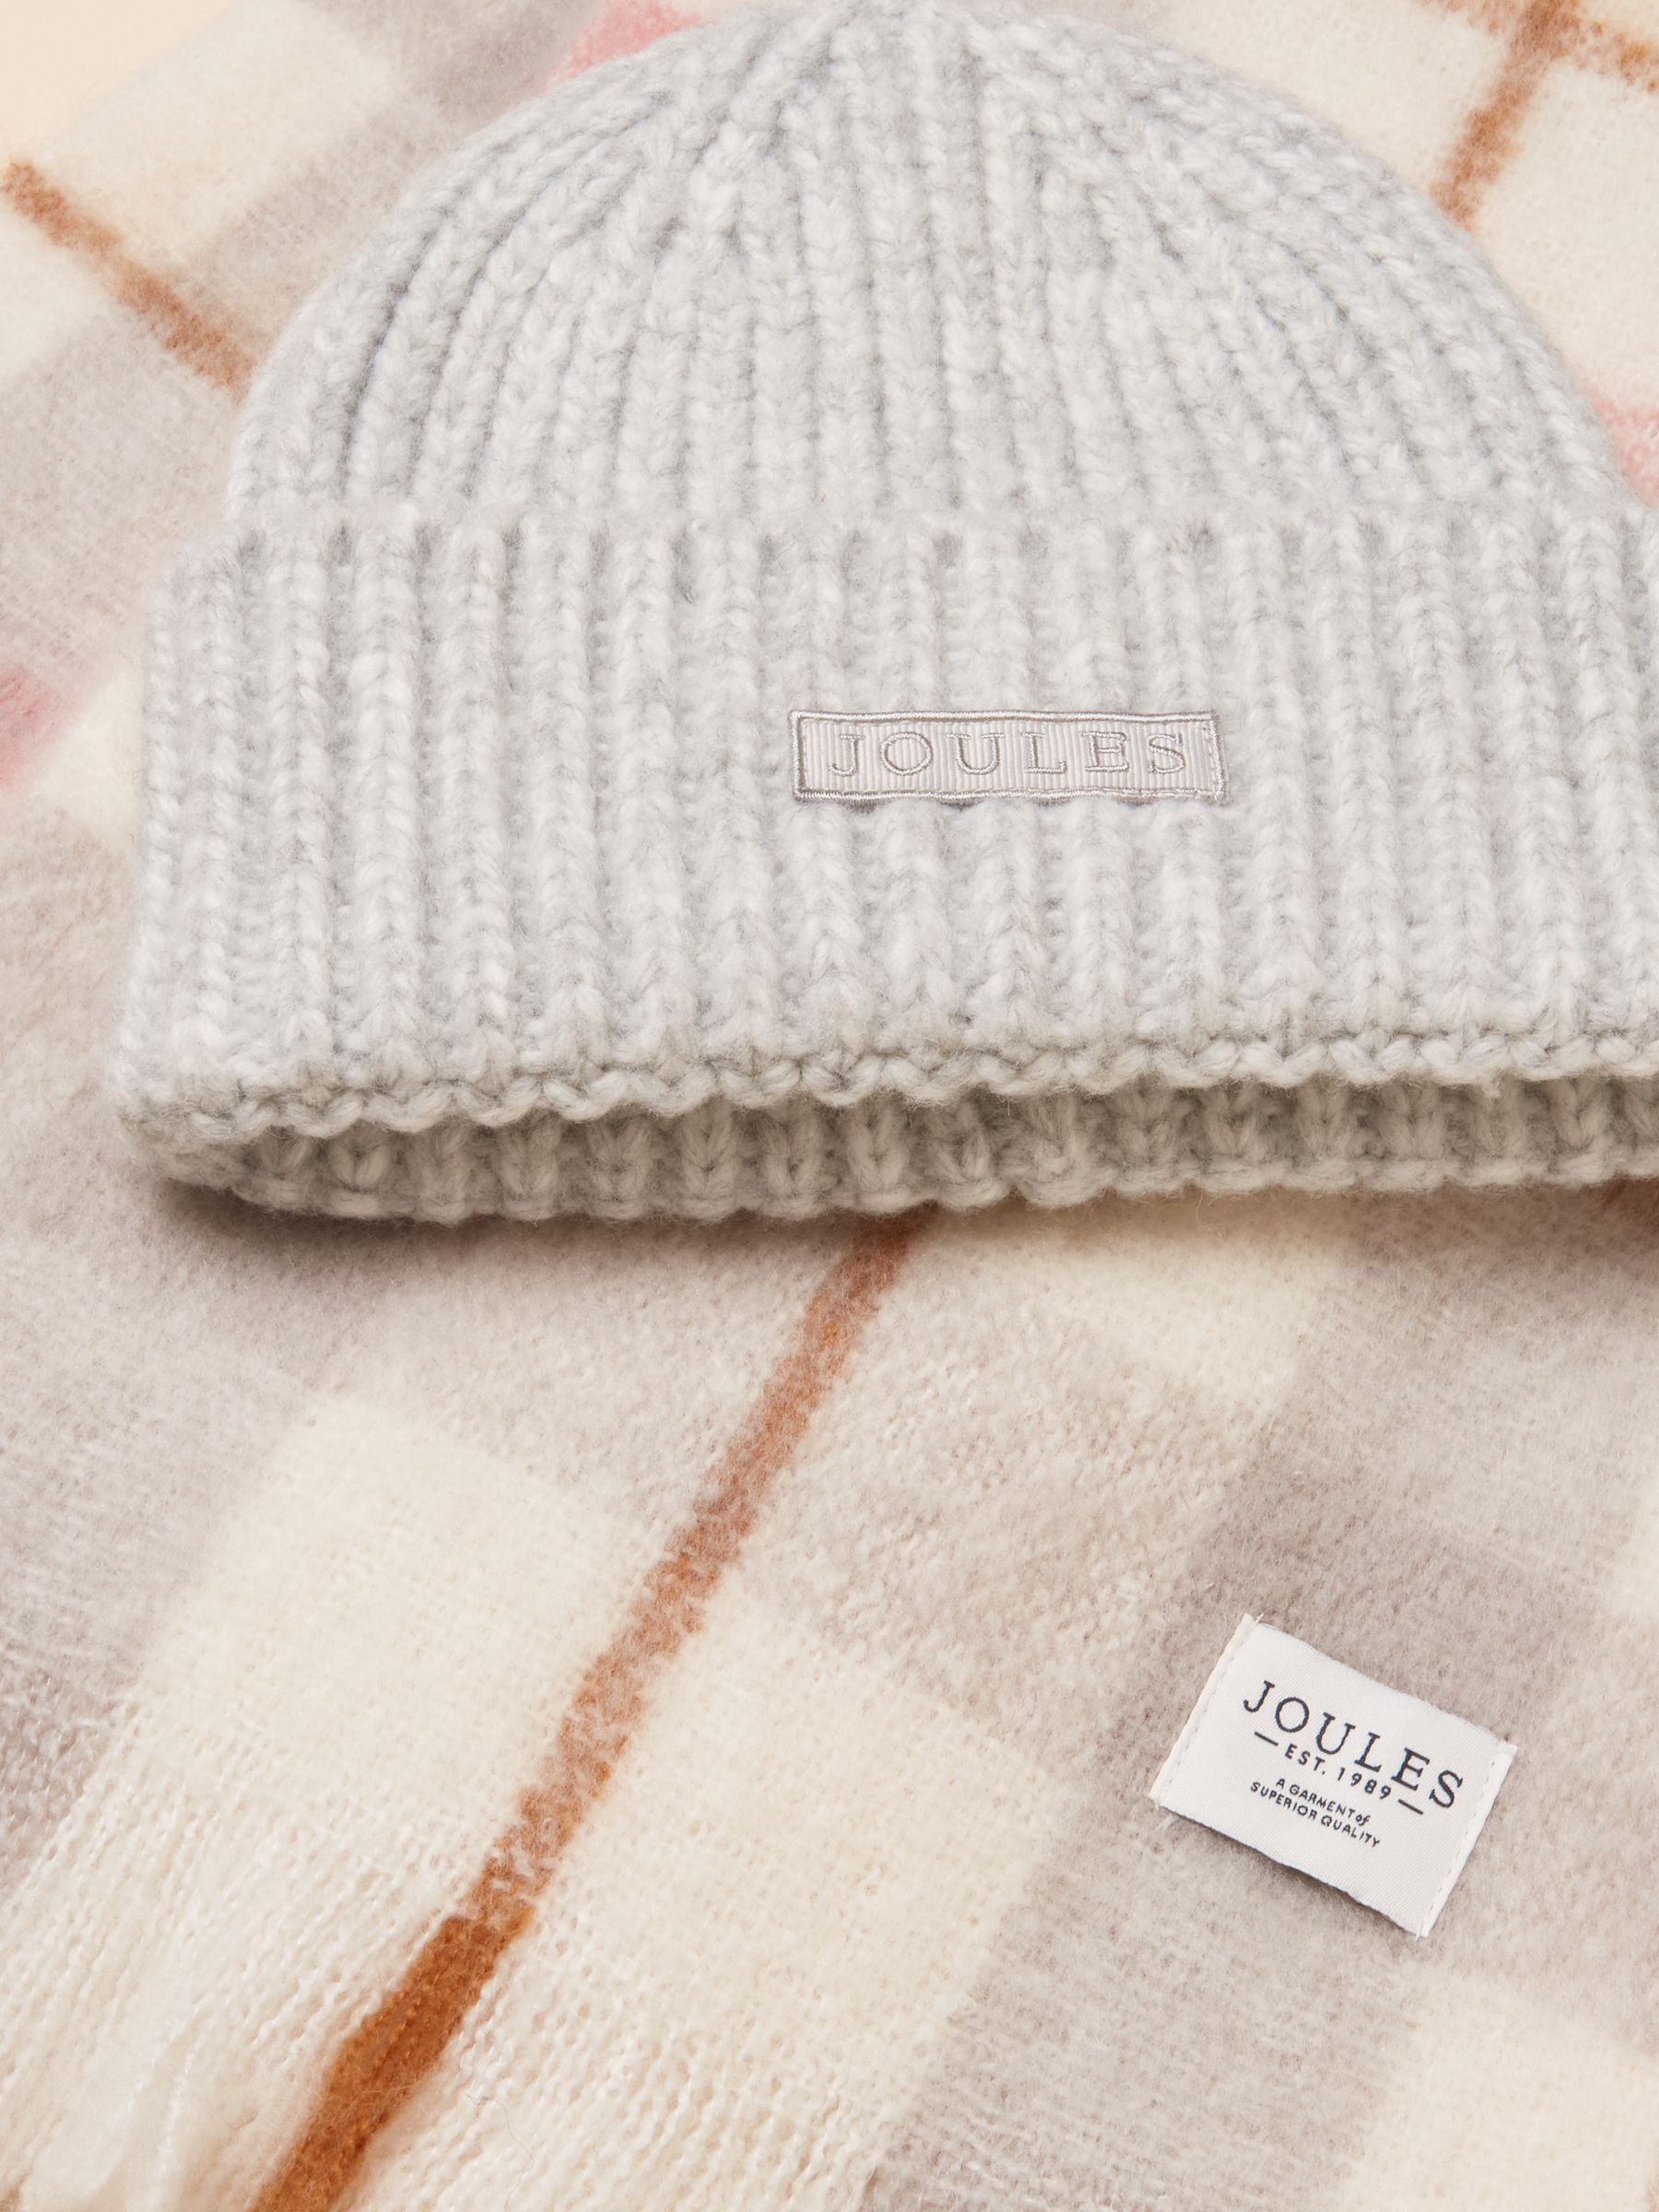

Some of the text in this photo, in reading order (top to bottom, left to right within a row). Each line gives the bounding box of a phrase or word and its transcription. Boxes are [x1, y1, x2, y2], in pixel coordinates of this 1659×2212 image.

[830, 730, 1186, 776] JOULES
[1243, 1680, 1463, 1808] JOULES
[1285, 1743, 1392, 1800] EST. 1989
[1251, 1782, 1381, 1848] SUPERIOR QUALITY
[1276, 1778, 1371, 1827] A GARMENT of
